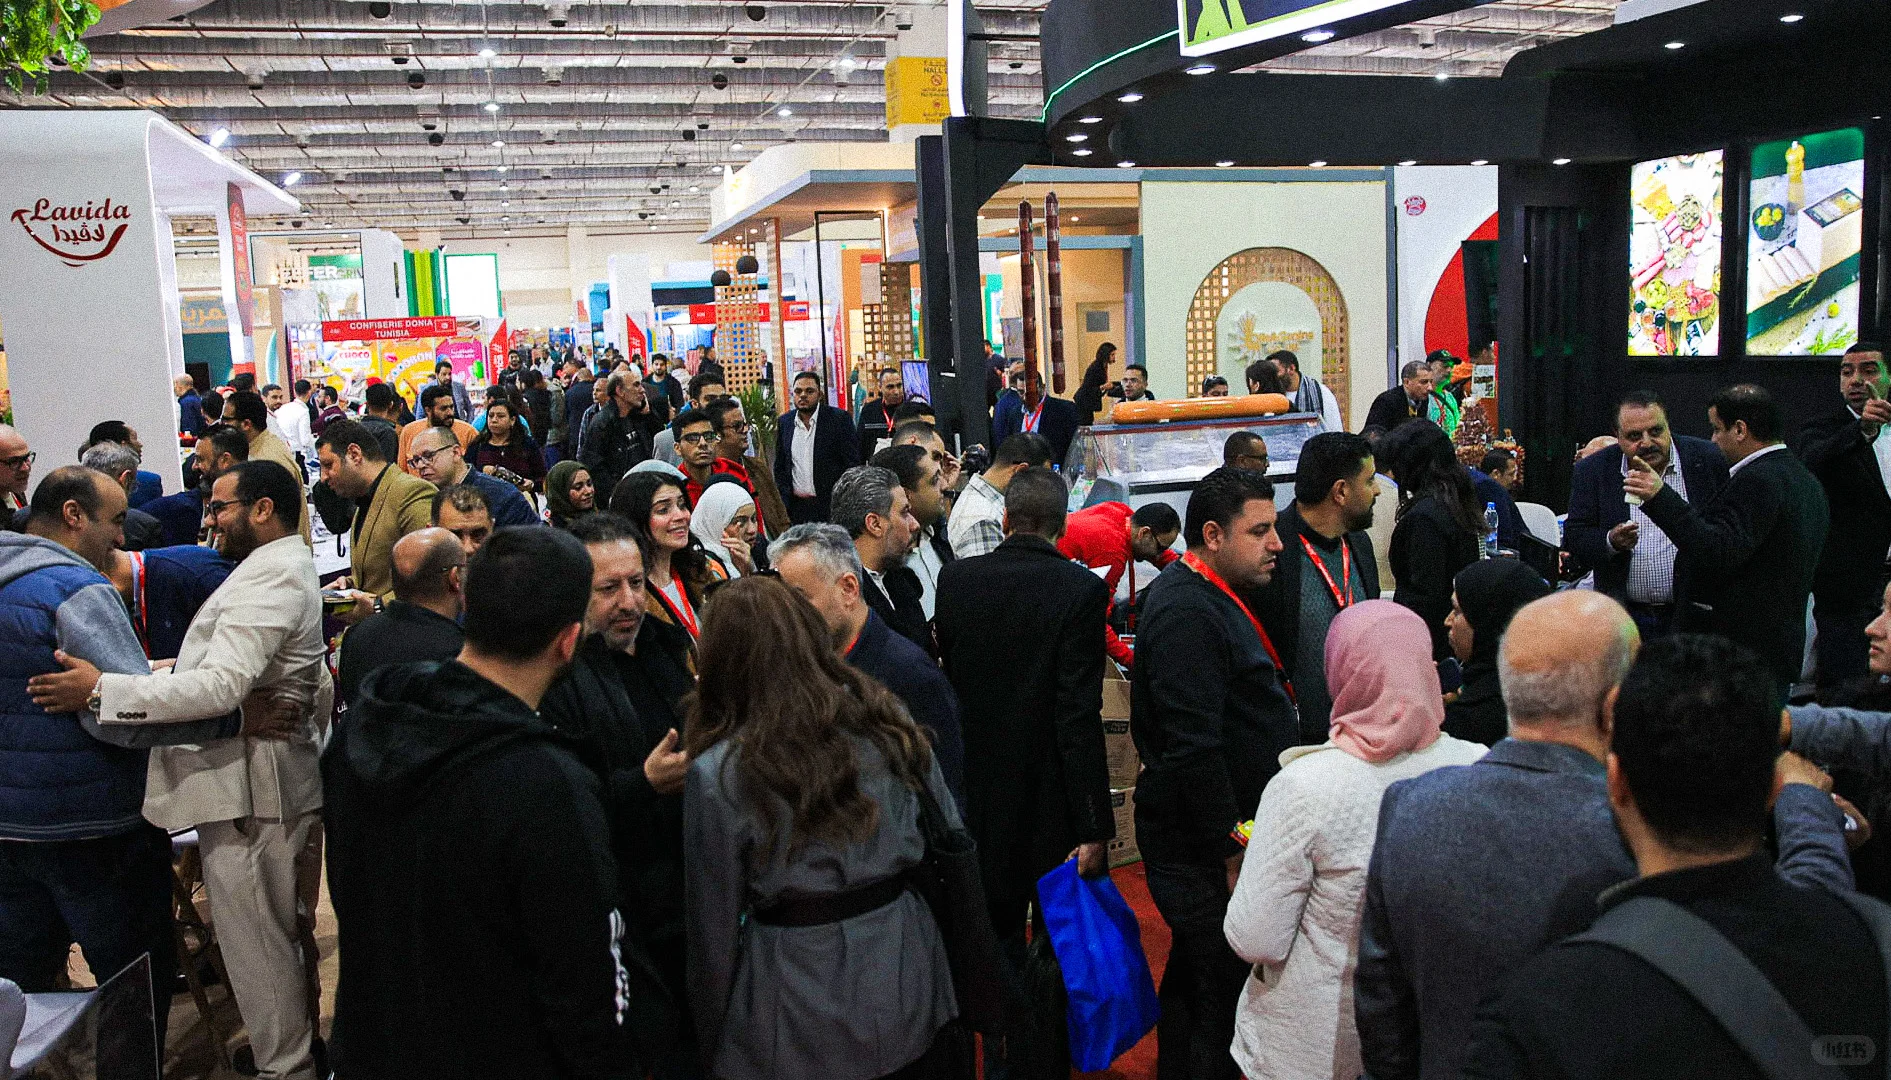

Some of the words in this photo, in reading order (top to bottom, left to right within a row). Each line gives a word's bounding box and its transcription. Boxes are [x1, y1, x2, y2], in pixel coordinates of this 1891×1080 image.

[29, 197, 131, 221] Lavida
[349, 321, 403, 331] CONFISERIE
[405, 319, 433, 328] DONIA
[375, 329, 410, 338] TUNISIA
